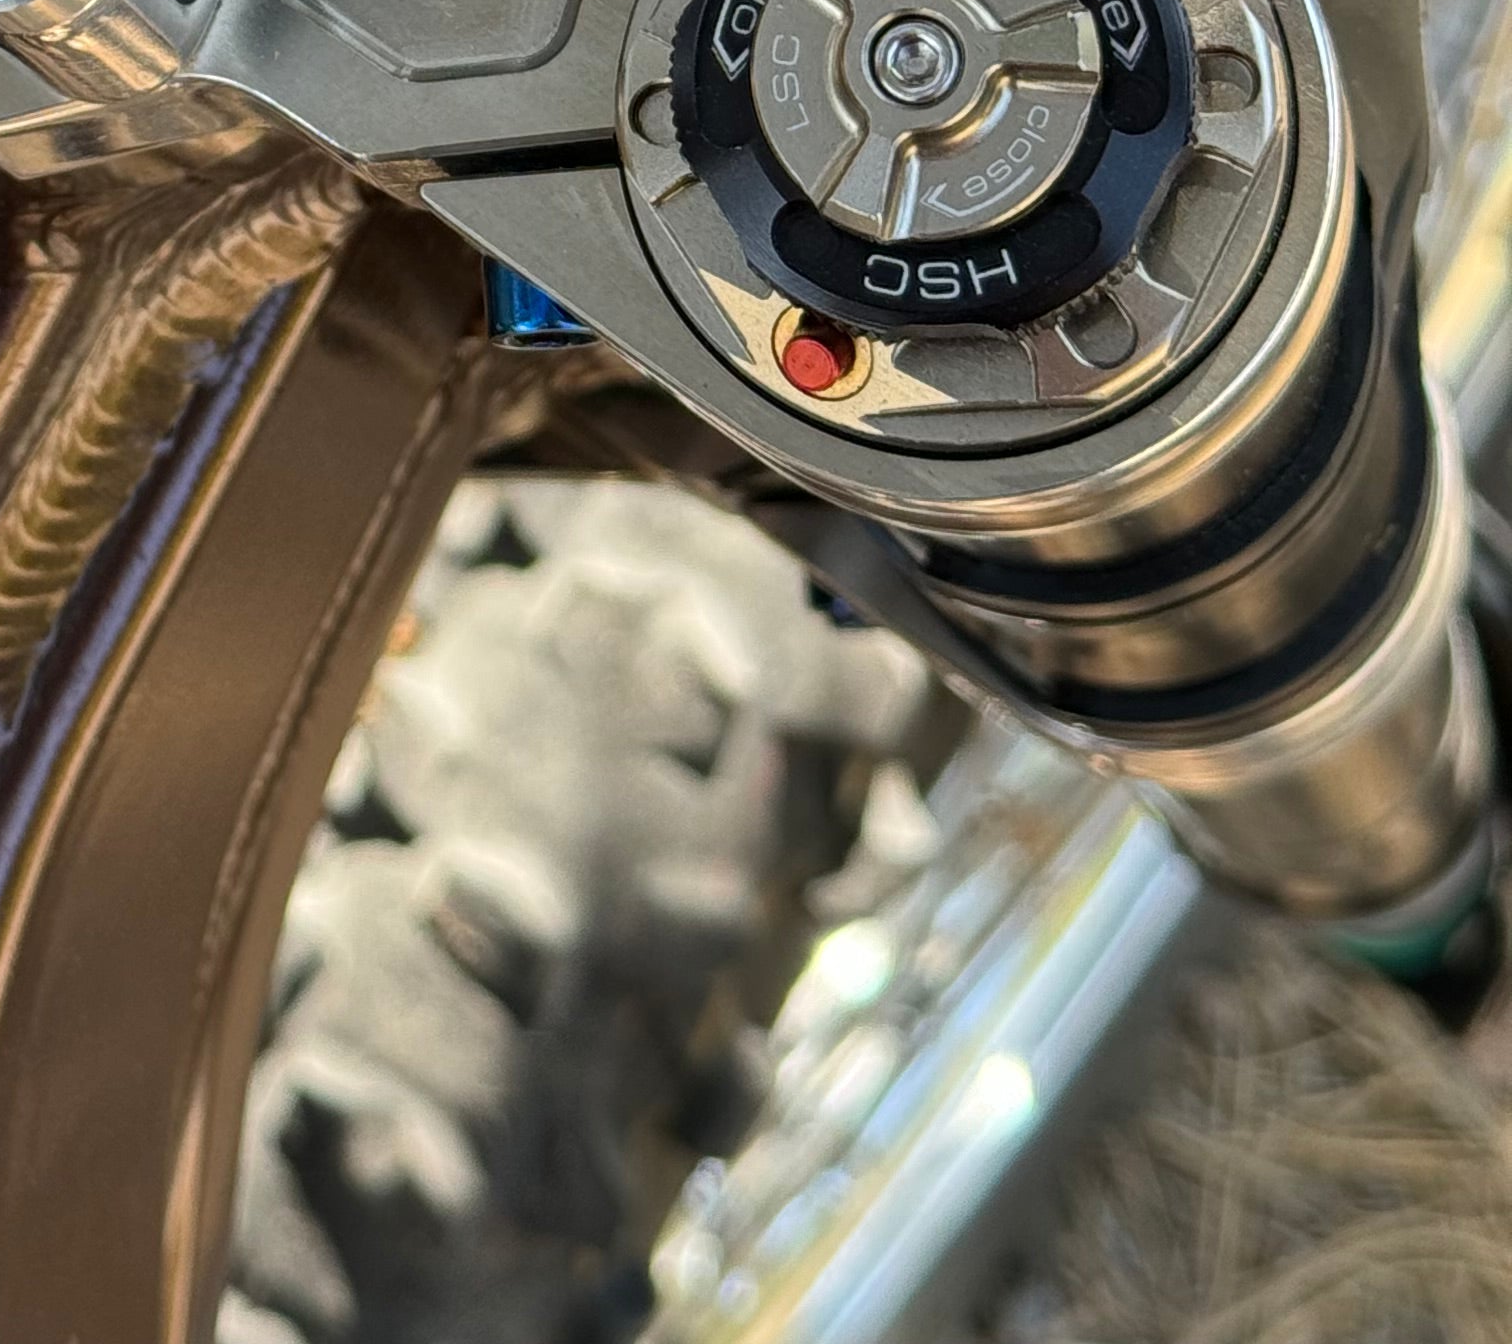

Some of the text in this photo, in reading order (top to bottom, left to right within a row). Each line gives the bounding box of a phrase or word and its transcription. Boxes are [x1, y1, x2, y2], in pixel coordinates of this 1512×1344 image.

[771, 33, 810, 132] LSC
[961, 104, 1050, 198] close
[863, 247, 1018, 300] HSC
